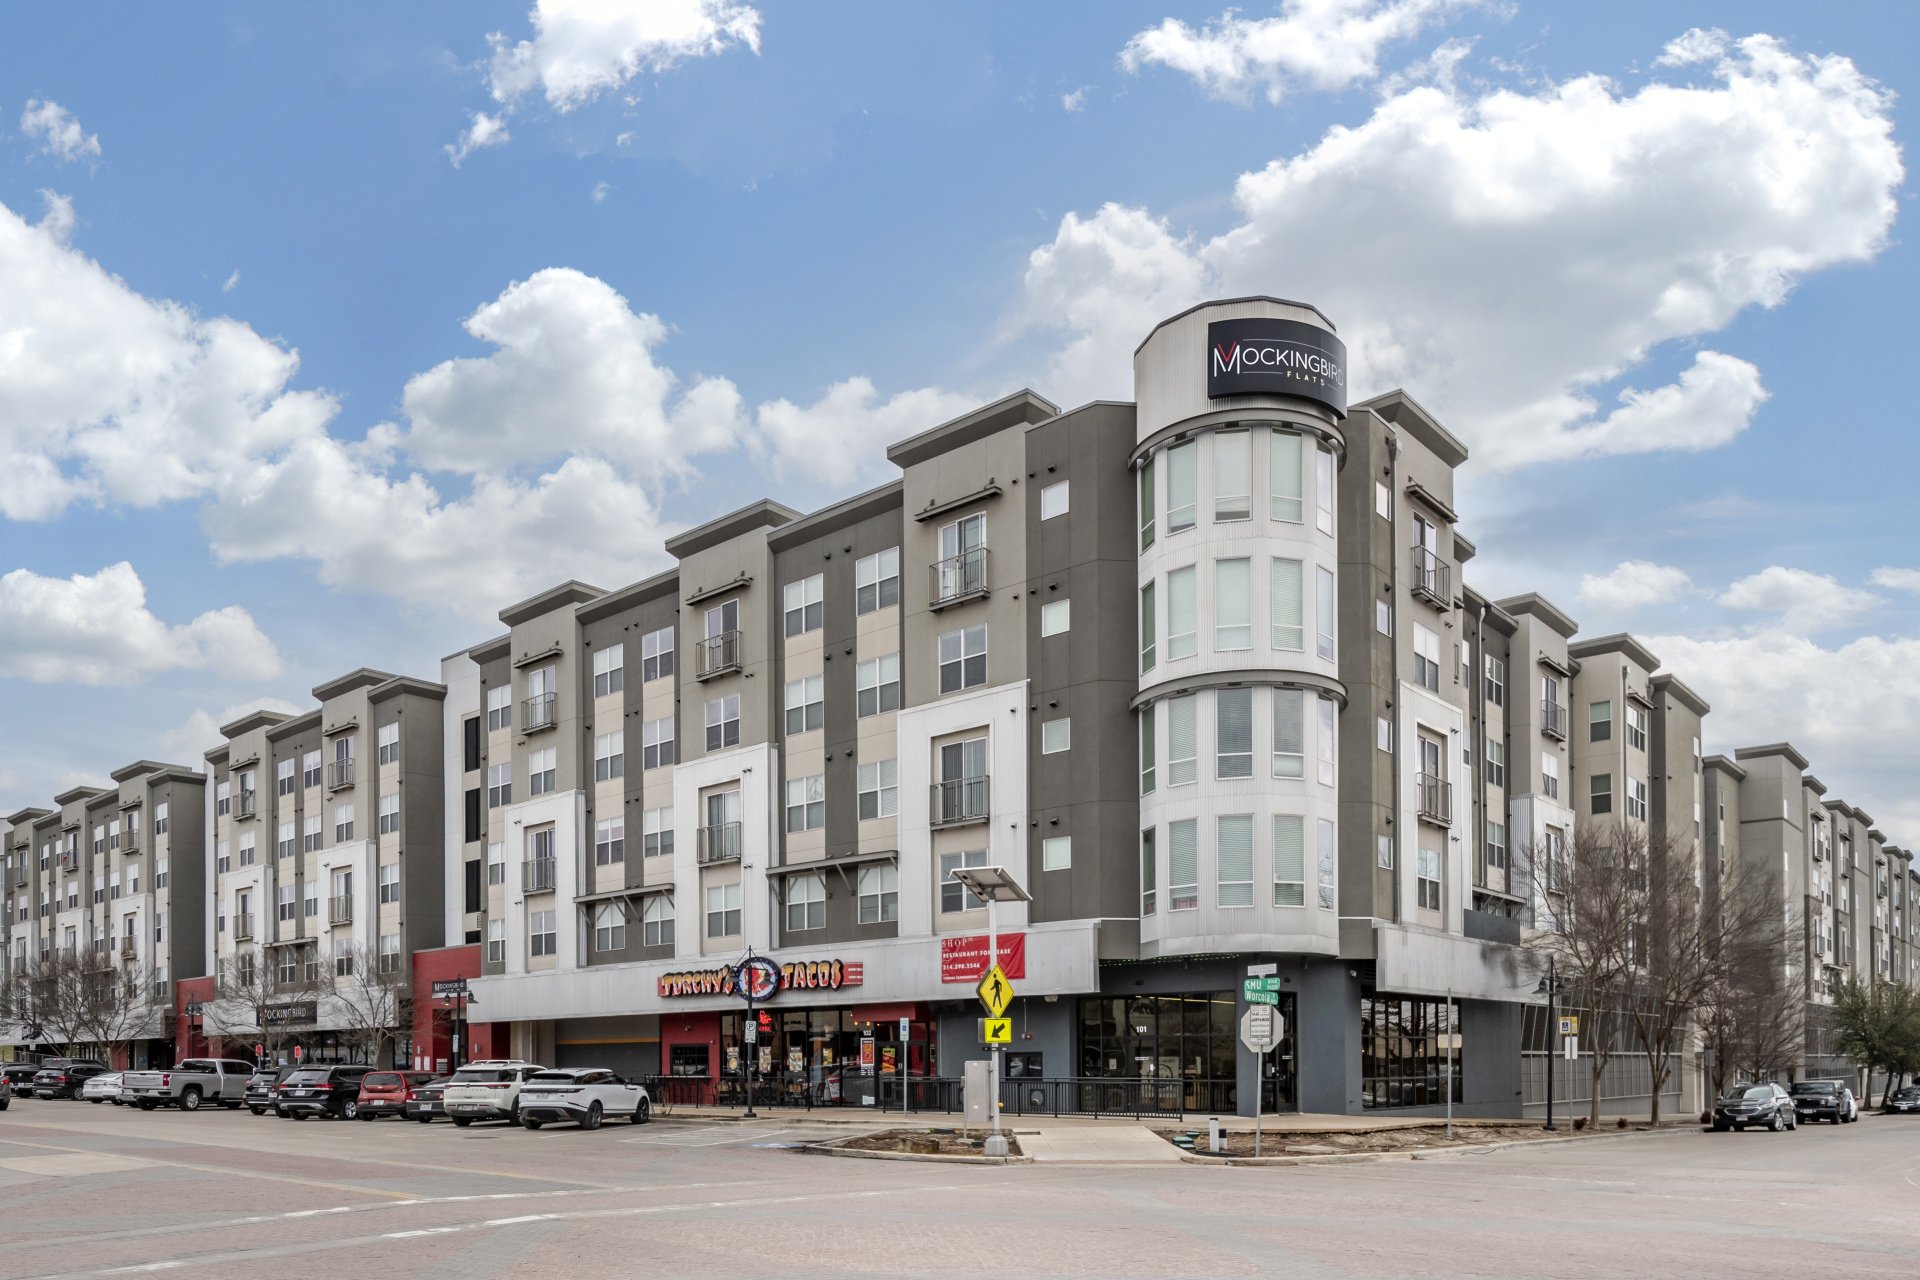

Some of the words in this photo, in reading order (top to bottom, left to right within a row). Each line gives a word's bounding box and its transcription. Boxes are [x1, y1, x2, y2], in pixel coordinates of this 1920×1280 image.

[1214, 341, 1344, 386] MOCKINGBIRD
[1287, 371, 1325, 386] FLATS
[943, 951, 978, 959] RESTAURANT
[780, 959, 844, 992] TACOS
[1246, 980, 1262, 990] SMU
[1246, 991, 1270, 1003] Worcola
